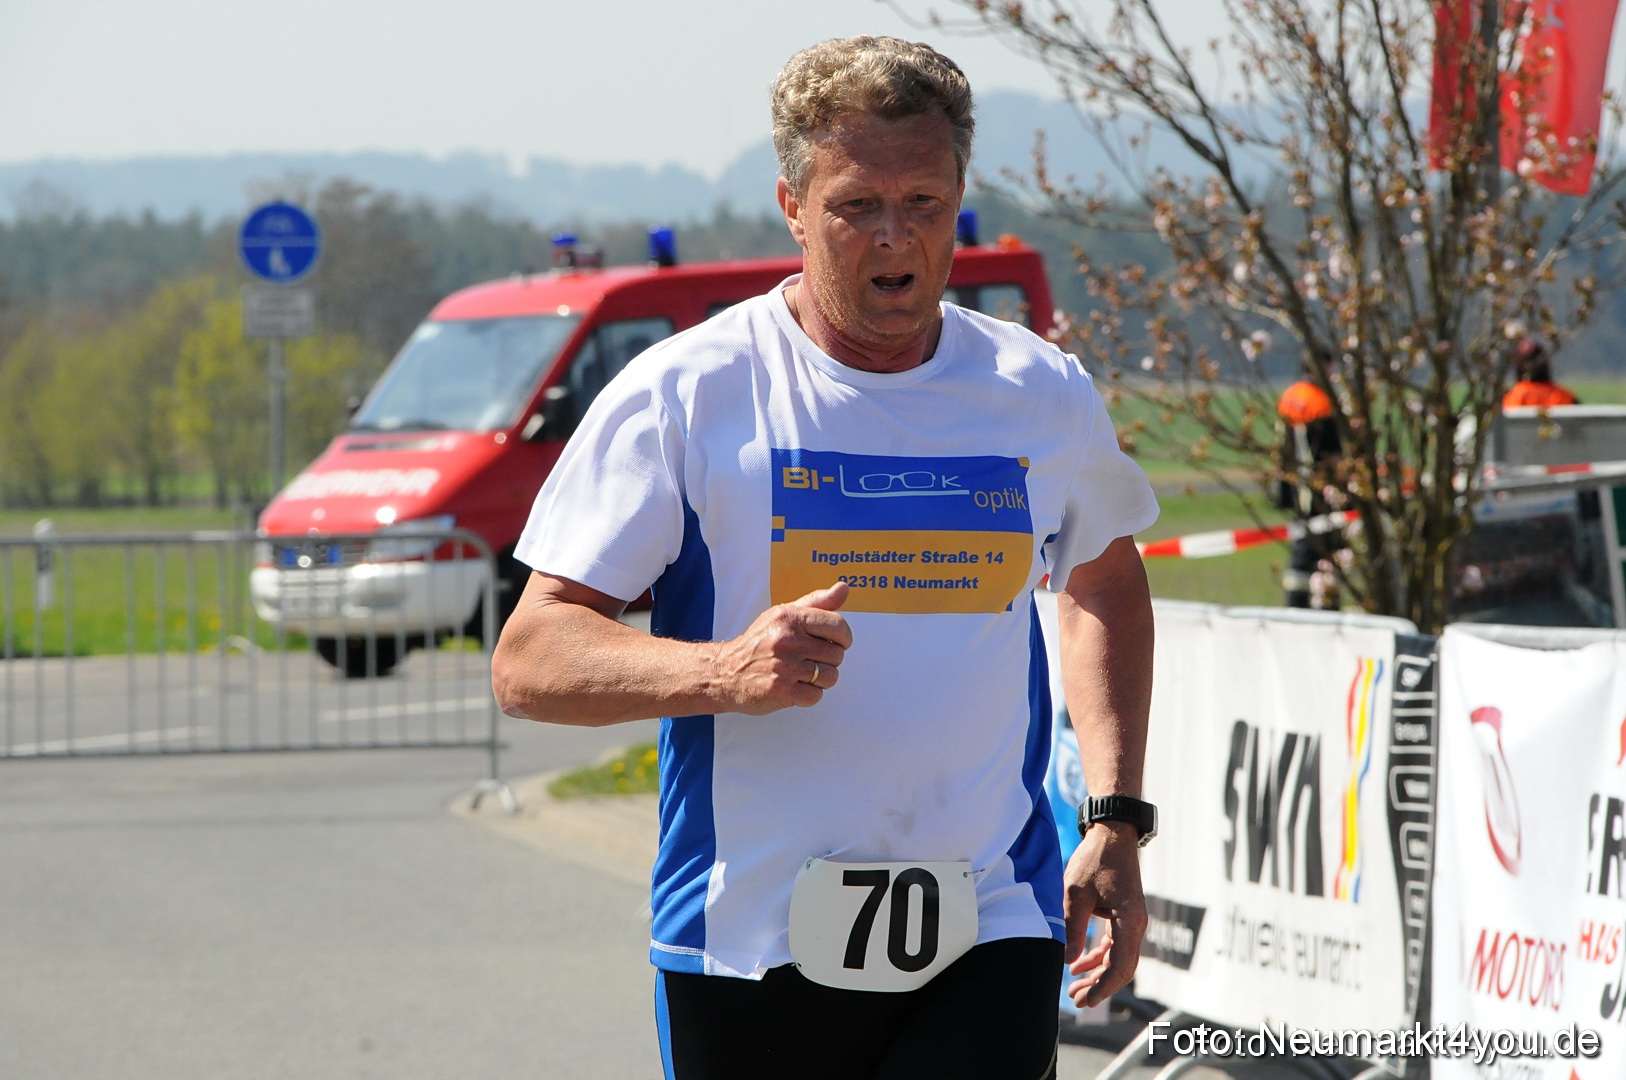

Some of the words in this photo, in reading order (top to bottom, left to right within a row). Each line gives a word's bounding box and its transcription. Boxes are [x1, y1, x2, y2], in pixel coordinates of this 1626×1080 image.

[973, 487, 1028, 514] optik
[811, 550, 915, 565] Ingolstädter
[920, 551, 979, 564] Straße
[984, 551, 1004, 564] 14
[893, 576, 979, 589] Neumarkt
[841, 867, 940, 973] 70
